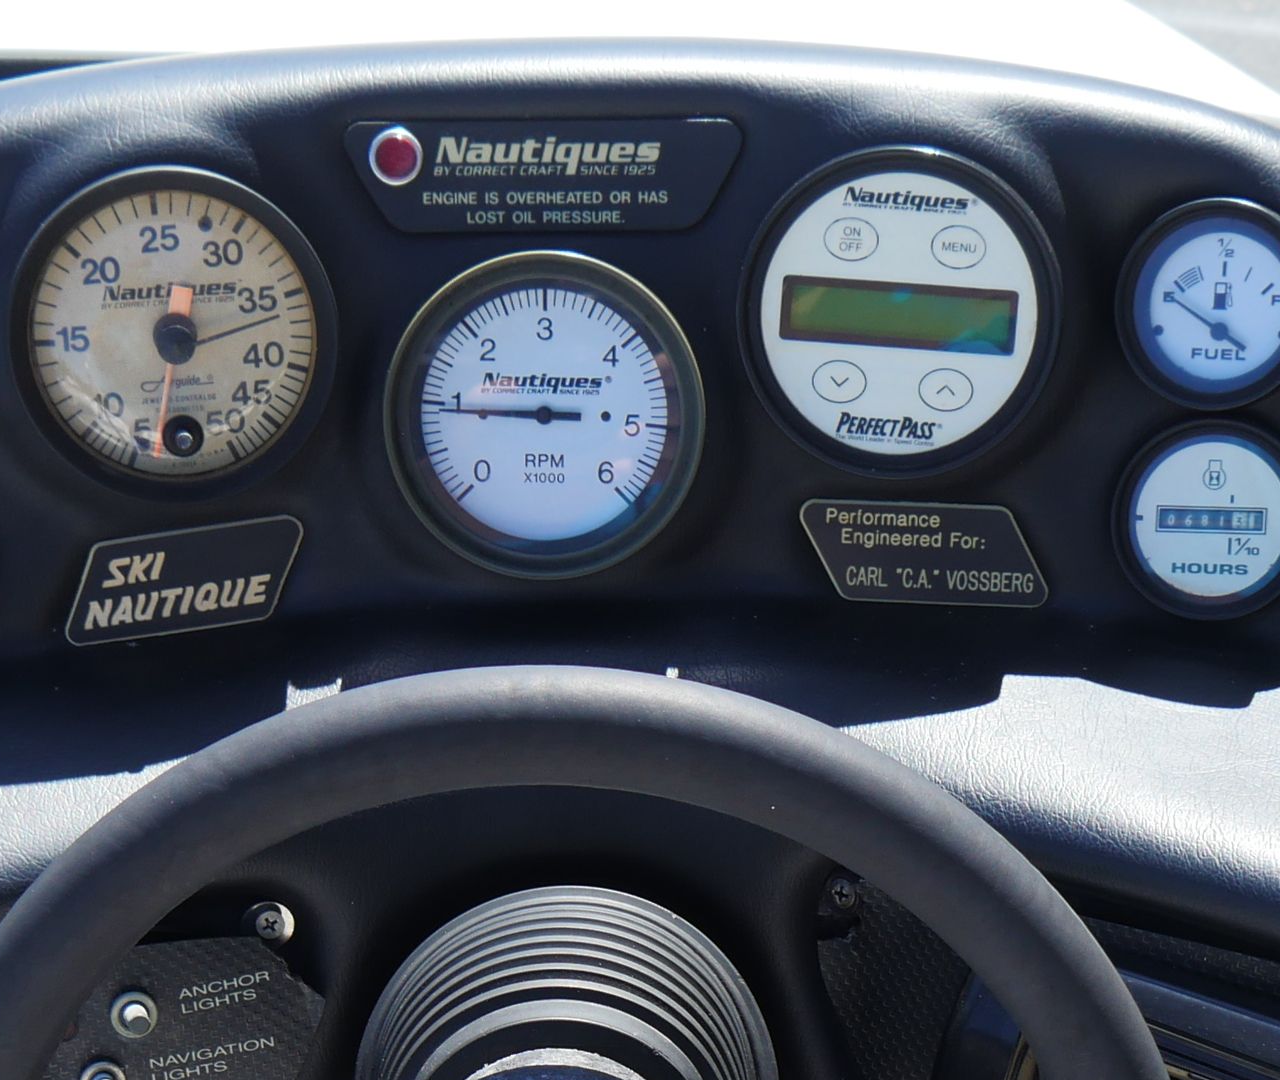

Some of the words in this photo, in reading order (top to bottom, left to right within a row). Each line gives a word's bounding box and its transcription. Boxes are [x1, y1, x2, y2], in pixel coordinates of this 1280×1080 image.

[435, 136, 661, 175] Nautiques
[434, 166, 453, 176] BY
[456, 165, 518, 176] CORRECT
[520, 165, 564, 176] CRAFT
[580, 165, 619, 176] SINCE
[623, 164, 656, 175] 1925
[423, 192, 477, 205] ENGINE
[485, 192, 499, 205] IS
[506, 191, 602, 205] OVERHEATED
[609, 191, 631, 205] OR
[638, 190, 669, 204] HAS
[844, 186, 969, 212] Nautiques
[467, 210, 505, 225] LOST
[512, 210, 536, 224] OIL
[543, 210, 625, 224] PRESSURE.
[139, 224, 180, 254] 25
[843, 226, 862, 238] ON
[202, 239, 244, 267] 30
[839, 241, 863, 253] OFF
[941, 242, 977, 254] MENU
[81, 256, 120, 285] 20
[102, 281, 237, 302] Nautiues
[237, 285, 278, 313] 35
[1163, 291, 1175, 302] E
[55, 325, 90, 352] 15
[536, 317, 553, 341] 3
[242, 341, 285, 368] 40
[480, 338, 496, 362] 2
[602, 345, 619, 368] 4
[1191, 348, 1246, 361] FUEL
[231, 379, 273, 405] 45
[483, 372, 603, 393] Nautiques
[206, 408, 245, 435] 50
[624, 414, 641, 437] 5
[474, 459, 491, 482] 0
[524, 454, 565, 468] RPM
[598, 461, 615, 484] 6
[524, 472, 565, 484] X1000
[826, 508, 940, 528] Performance
[841, 528, 942, 548] Engineered
[950, 532, 986, 549] For:
[102, 551, 165, 588] SKI
[846, 566, 888, 587] CARL
[896, 567, 939, 589] "C.A."
[946, 570, 1034, 593] VOSSBERG
[1172, 563, 1248, 574] HOURS
[84, 574, 271, 630] NAUTIQUE
[179, 970, 270, 999] ANCHOR
[181, 989, 256, 1014] LIGHTS
[149, 1036, 275, 1069] NAVIGATION
